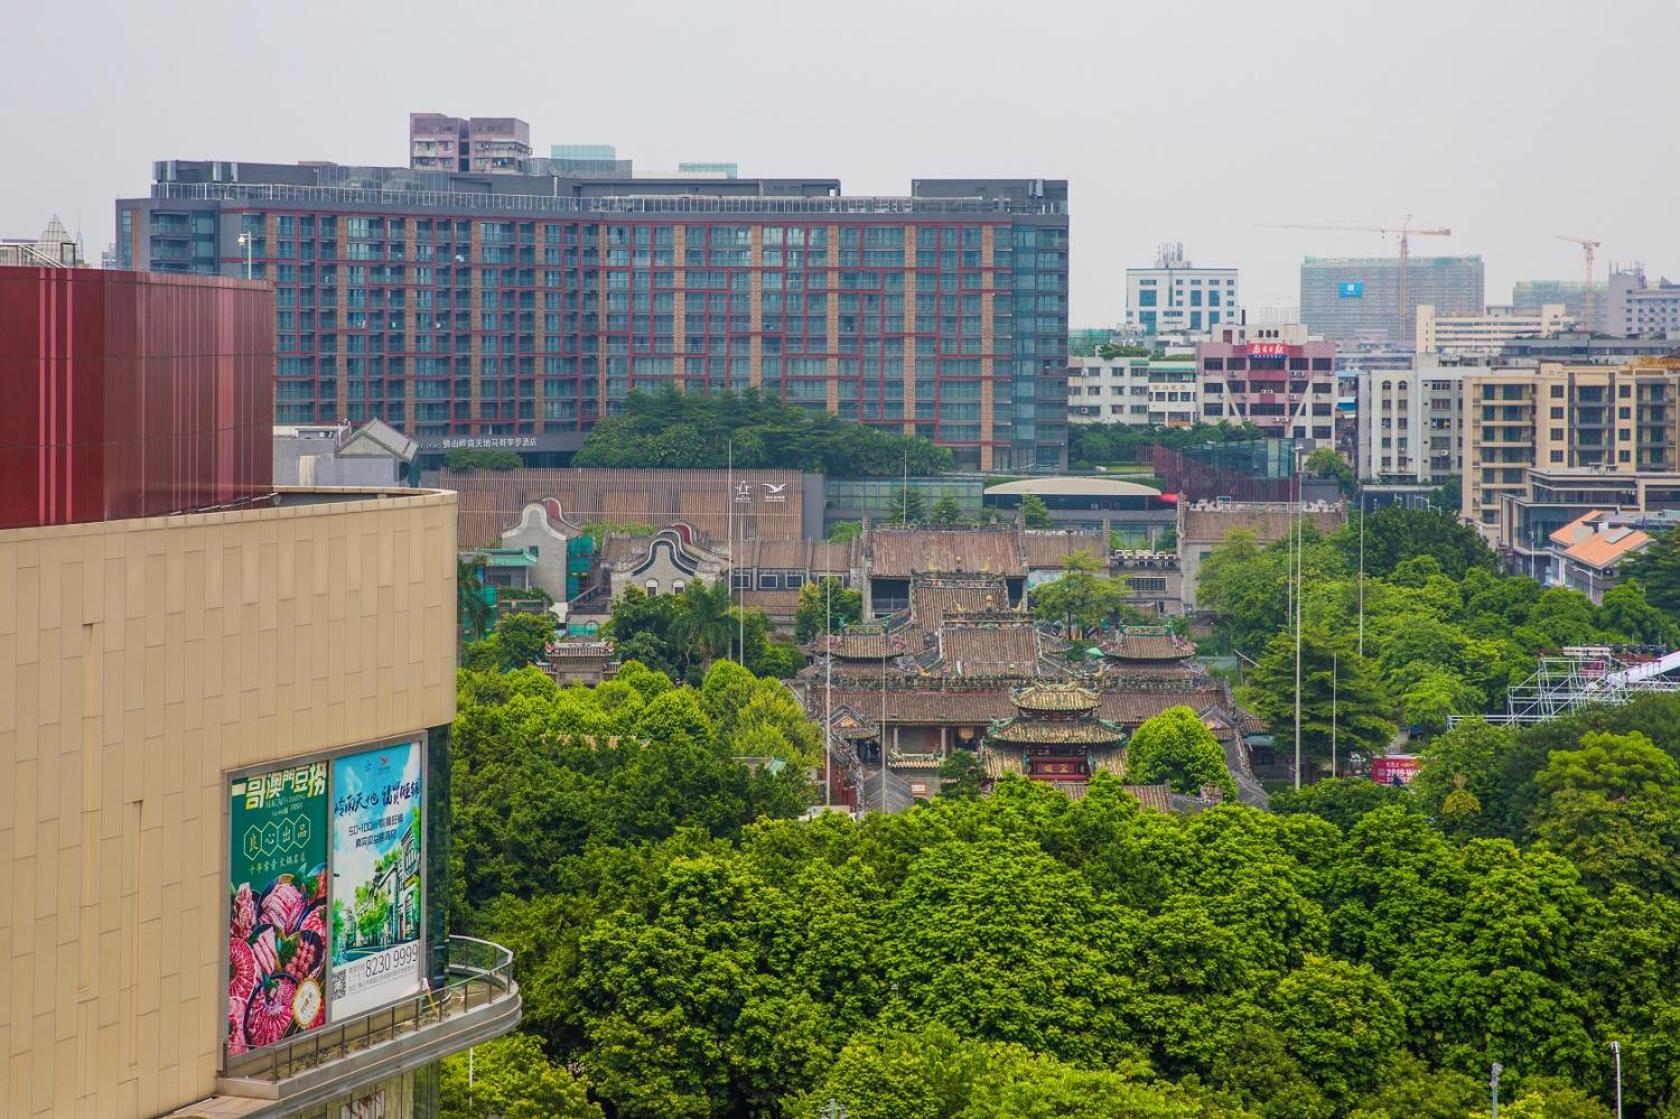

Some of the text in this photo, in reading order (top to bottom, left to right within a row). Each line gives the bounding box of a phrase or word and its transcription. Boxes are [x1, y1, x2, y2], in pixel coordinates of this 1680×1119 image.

[249, 823, 307, 852] 良心出品
[365, 953, 391, 978] 8230
[393, 943, 419, 968] 9999
